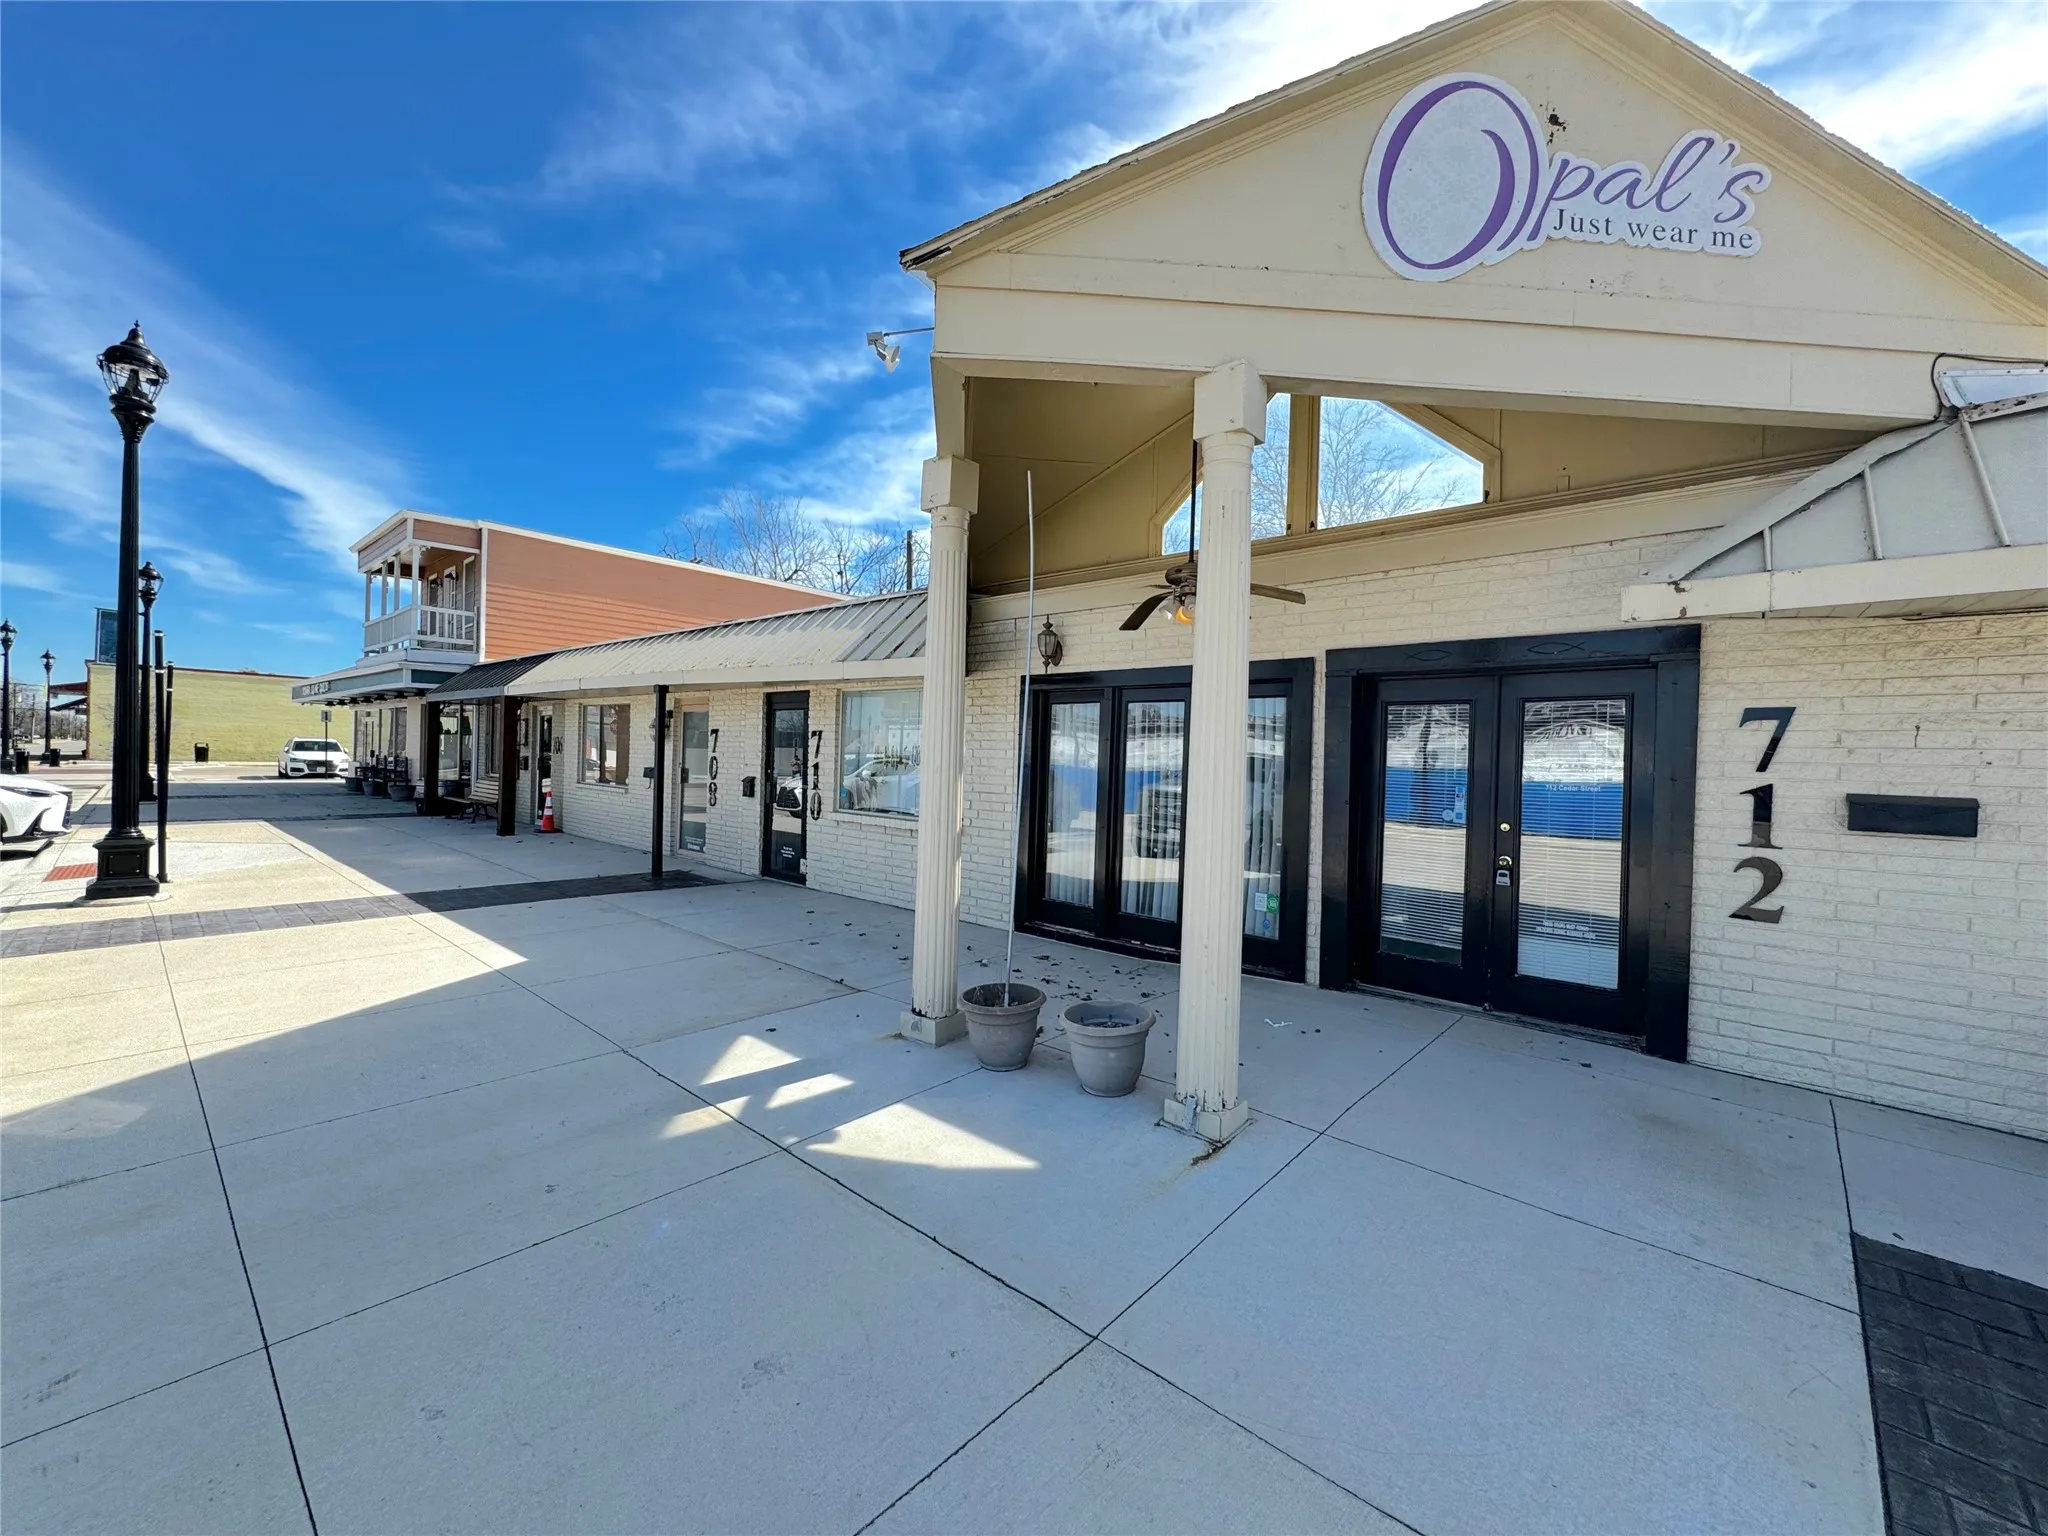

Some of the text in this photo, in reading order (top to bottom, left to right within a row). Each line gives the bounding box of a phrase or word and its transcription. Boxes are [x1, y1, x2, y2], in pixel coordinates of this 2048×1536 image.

[1377, 80, 1765, 271] Opal's
[1553, 208, 1754, 250] Just wear me
[708, 729, 720, 807] 708
[810, 730, 824, 821] 710
[1558, 784, 1578, 792] Cedar
[1728, 706, 1797, 924] 712
